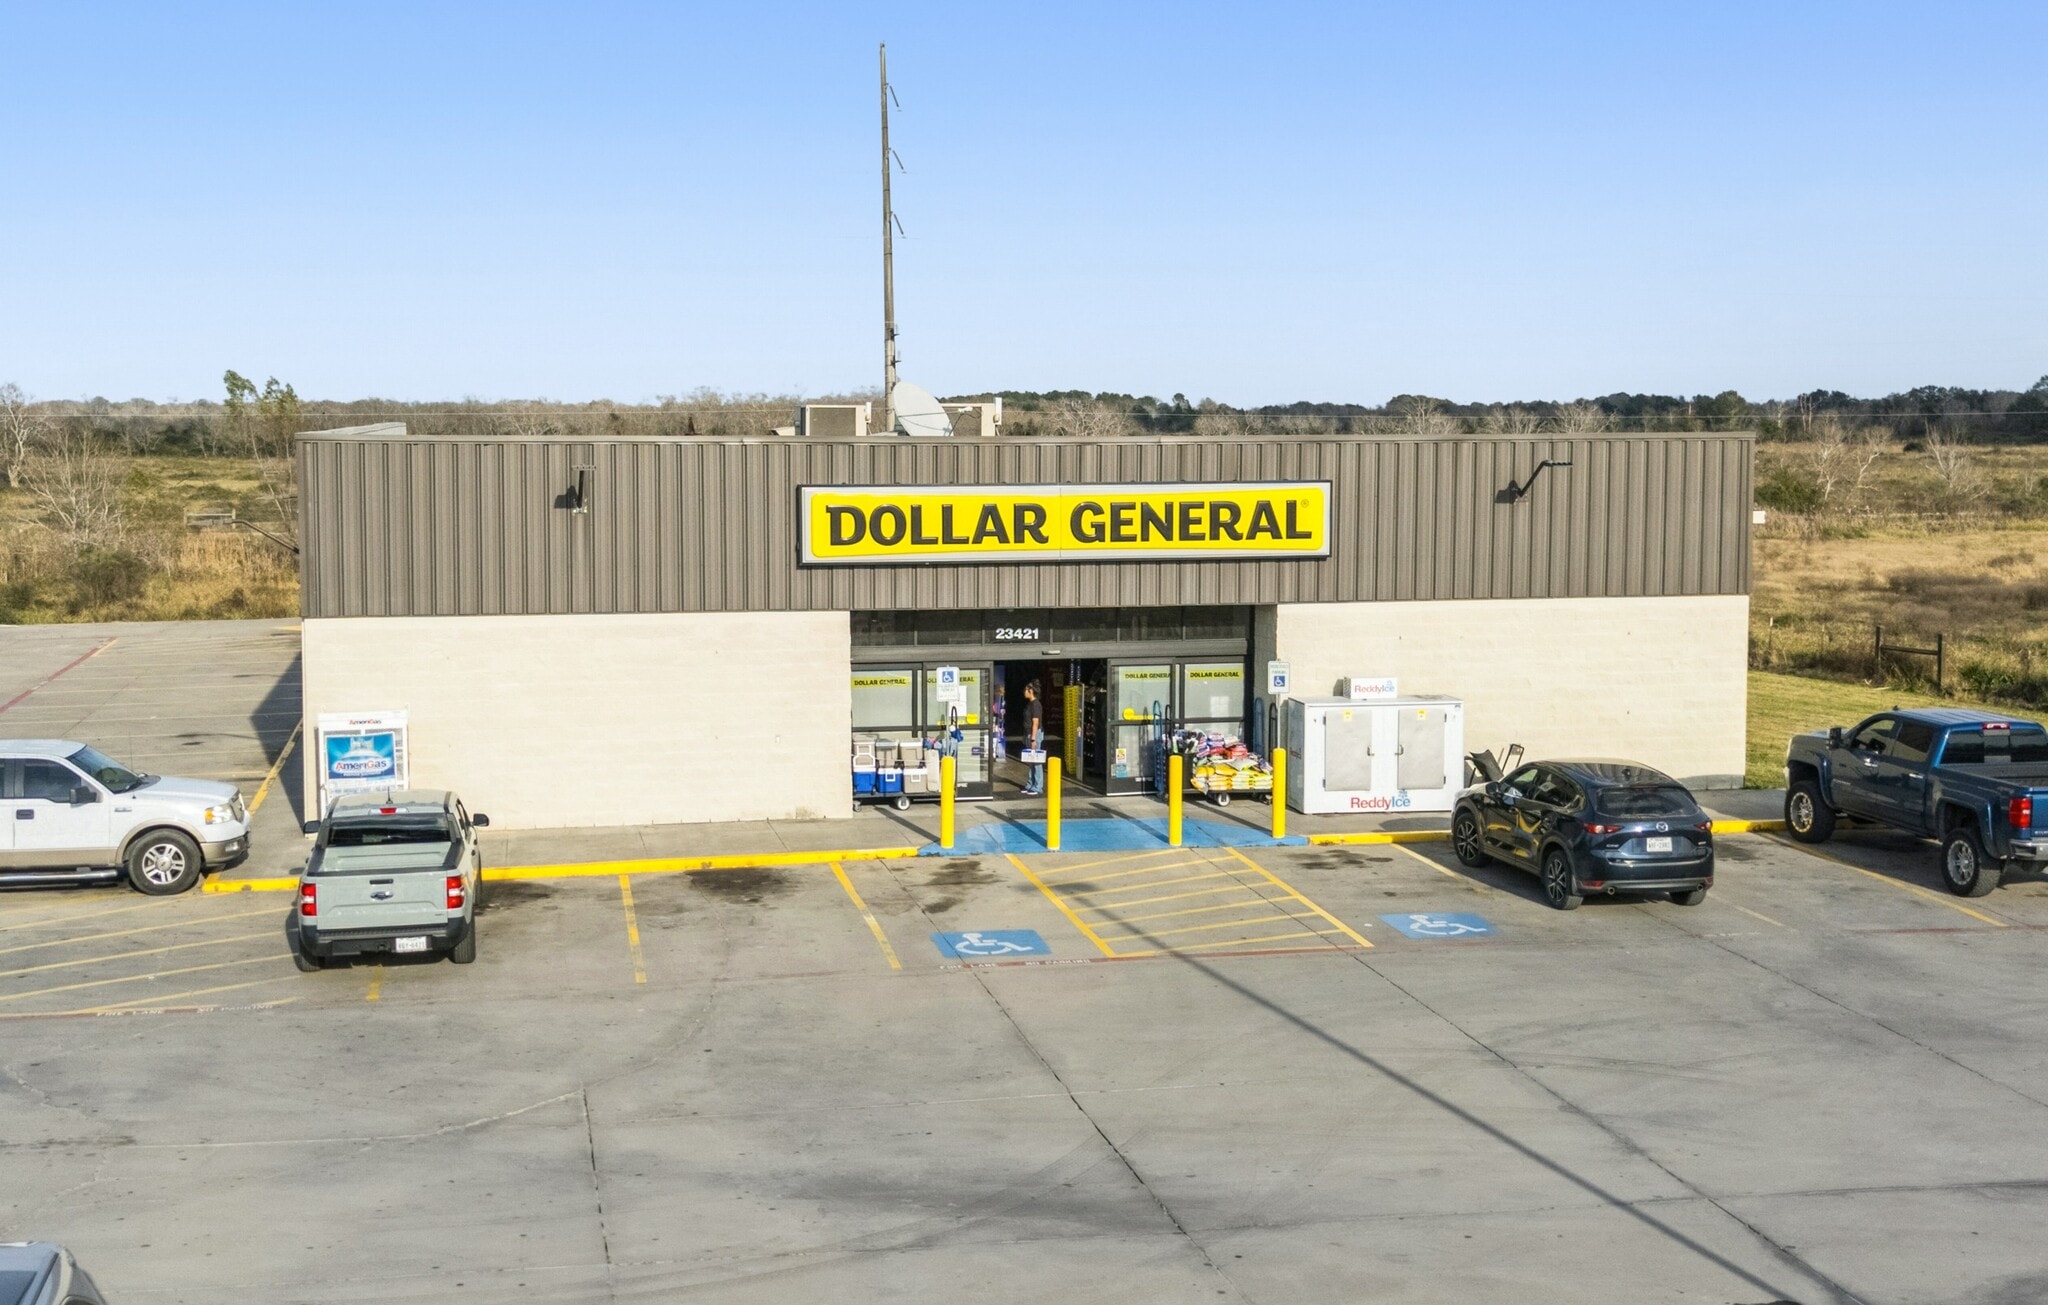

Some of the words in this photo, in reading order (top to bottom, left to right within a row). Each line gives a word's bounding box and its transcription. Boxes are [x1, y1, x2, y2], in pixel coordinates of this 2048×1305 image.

[826, 502, 1049, 546] DOLLAR
[1069, 500, 1312, 543] GENERAL
[995, 627, 1039, 640] 23421
[336, 760, 387, 770] AmeriGas
